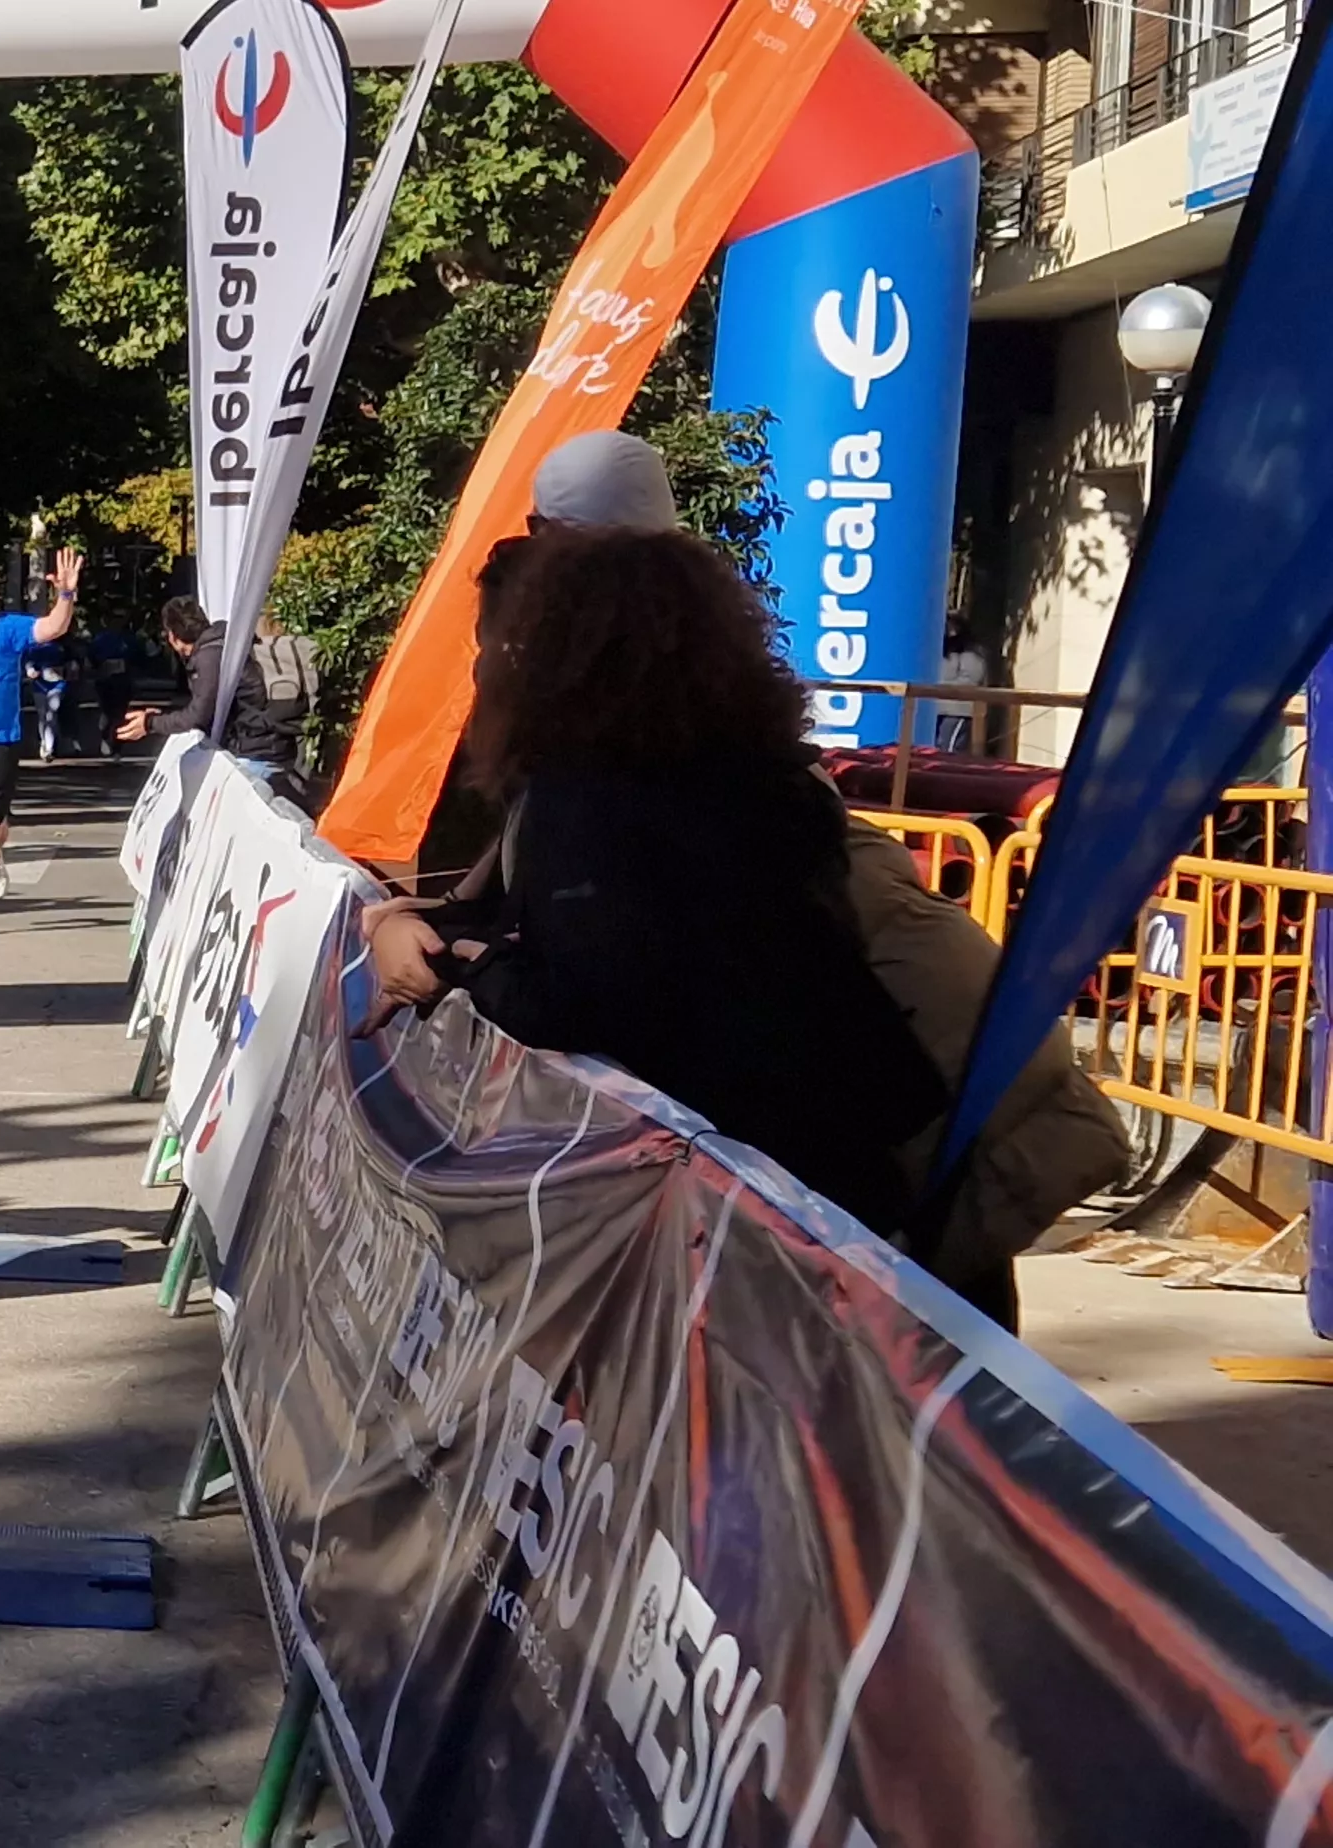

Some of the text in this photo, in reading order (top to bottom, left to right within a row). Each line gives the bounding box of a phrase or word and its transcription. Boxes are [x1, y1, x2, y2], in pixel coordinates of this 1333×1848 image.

[798, 430, 892, 749] Ibercaja
[495, 1388, 614, 1630] ESIC
[635, 1575, 787, 1848] ESIC
